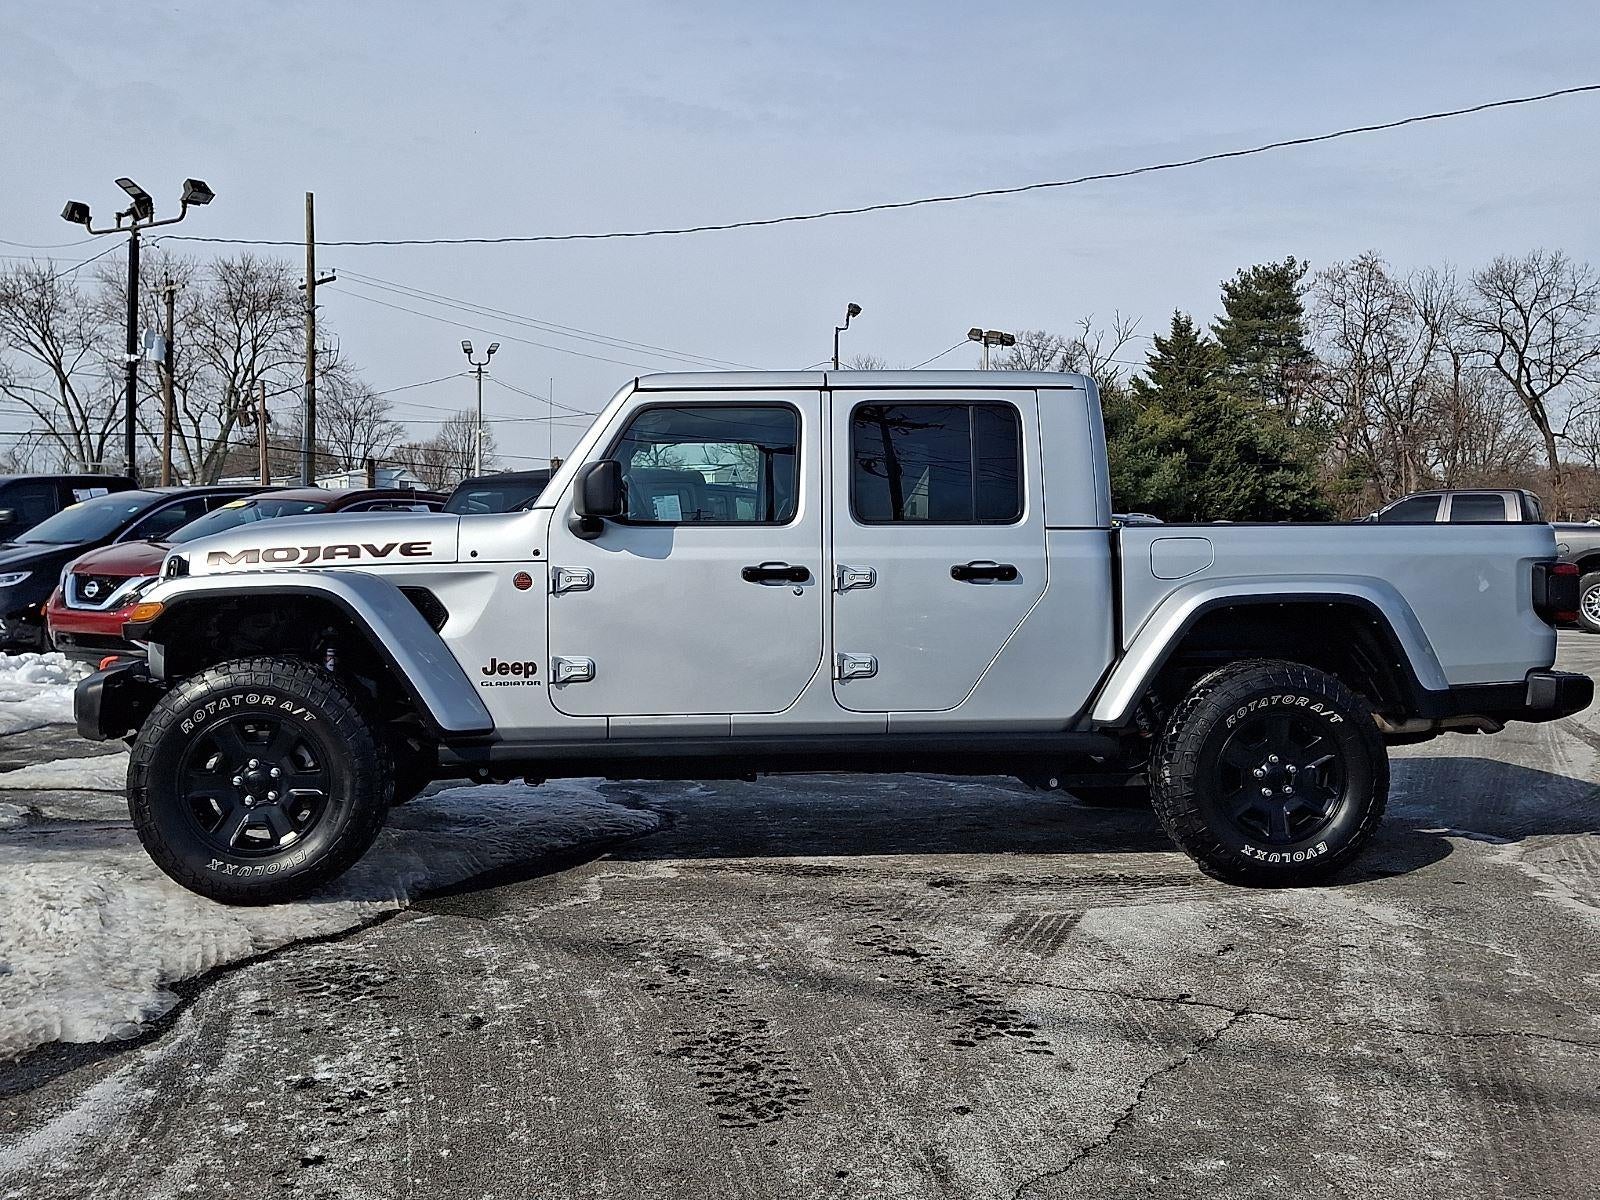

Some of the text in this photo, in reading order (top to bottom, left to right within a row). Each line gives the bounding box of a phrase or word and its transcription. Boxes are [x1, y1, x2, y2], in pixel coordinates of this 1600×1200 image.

[207, 541, 433, 566] MOJAVE
[481, 657, 538, 679] Jeep
[180, 693, 317, 734] ROTATOR A/T
[1226, 694, 1343, 729] ROTATOR A/T
[205, 849, 307, 877] EVOLUXX
[1240, 841, 1328, 863] EVOLUXX
